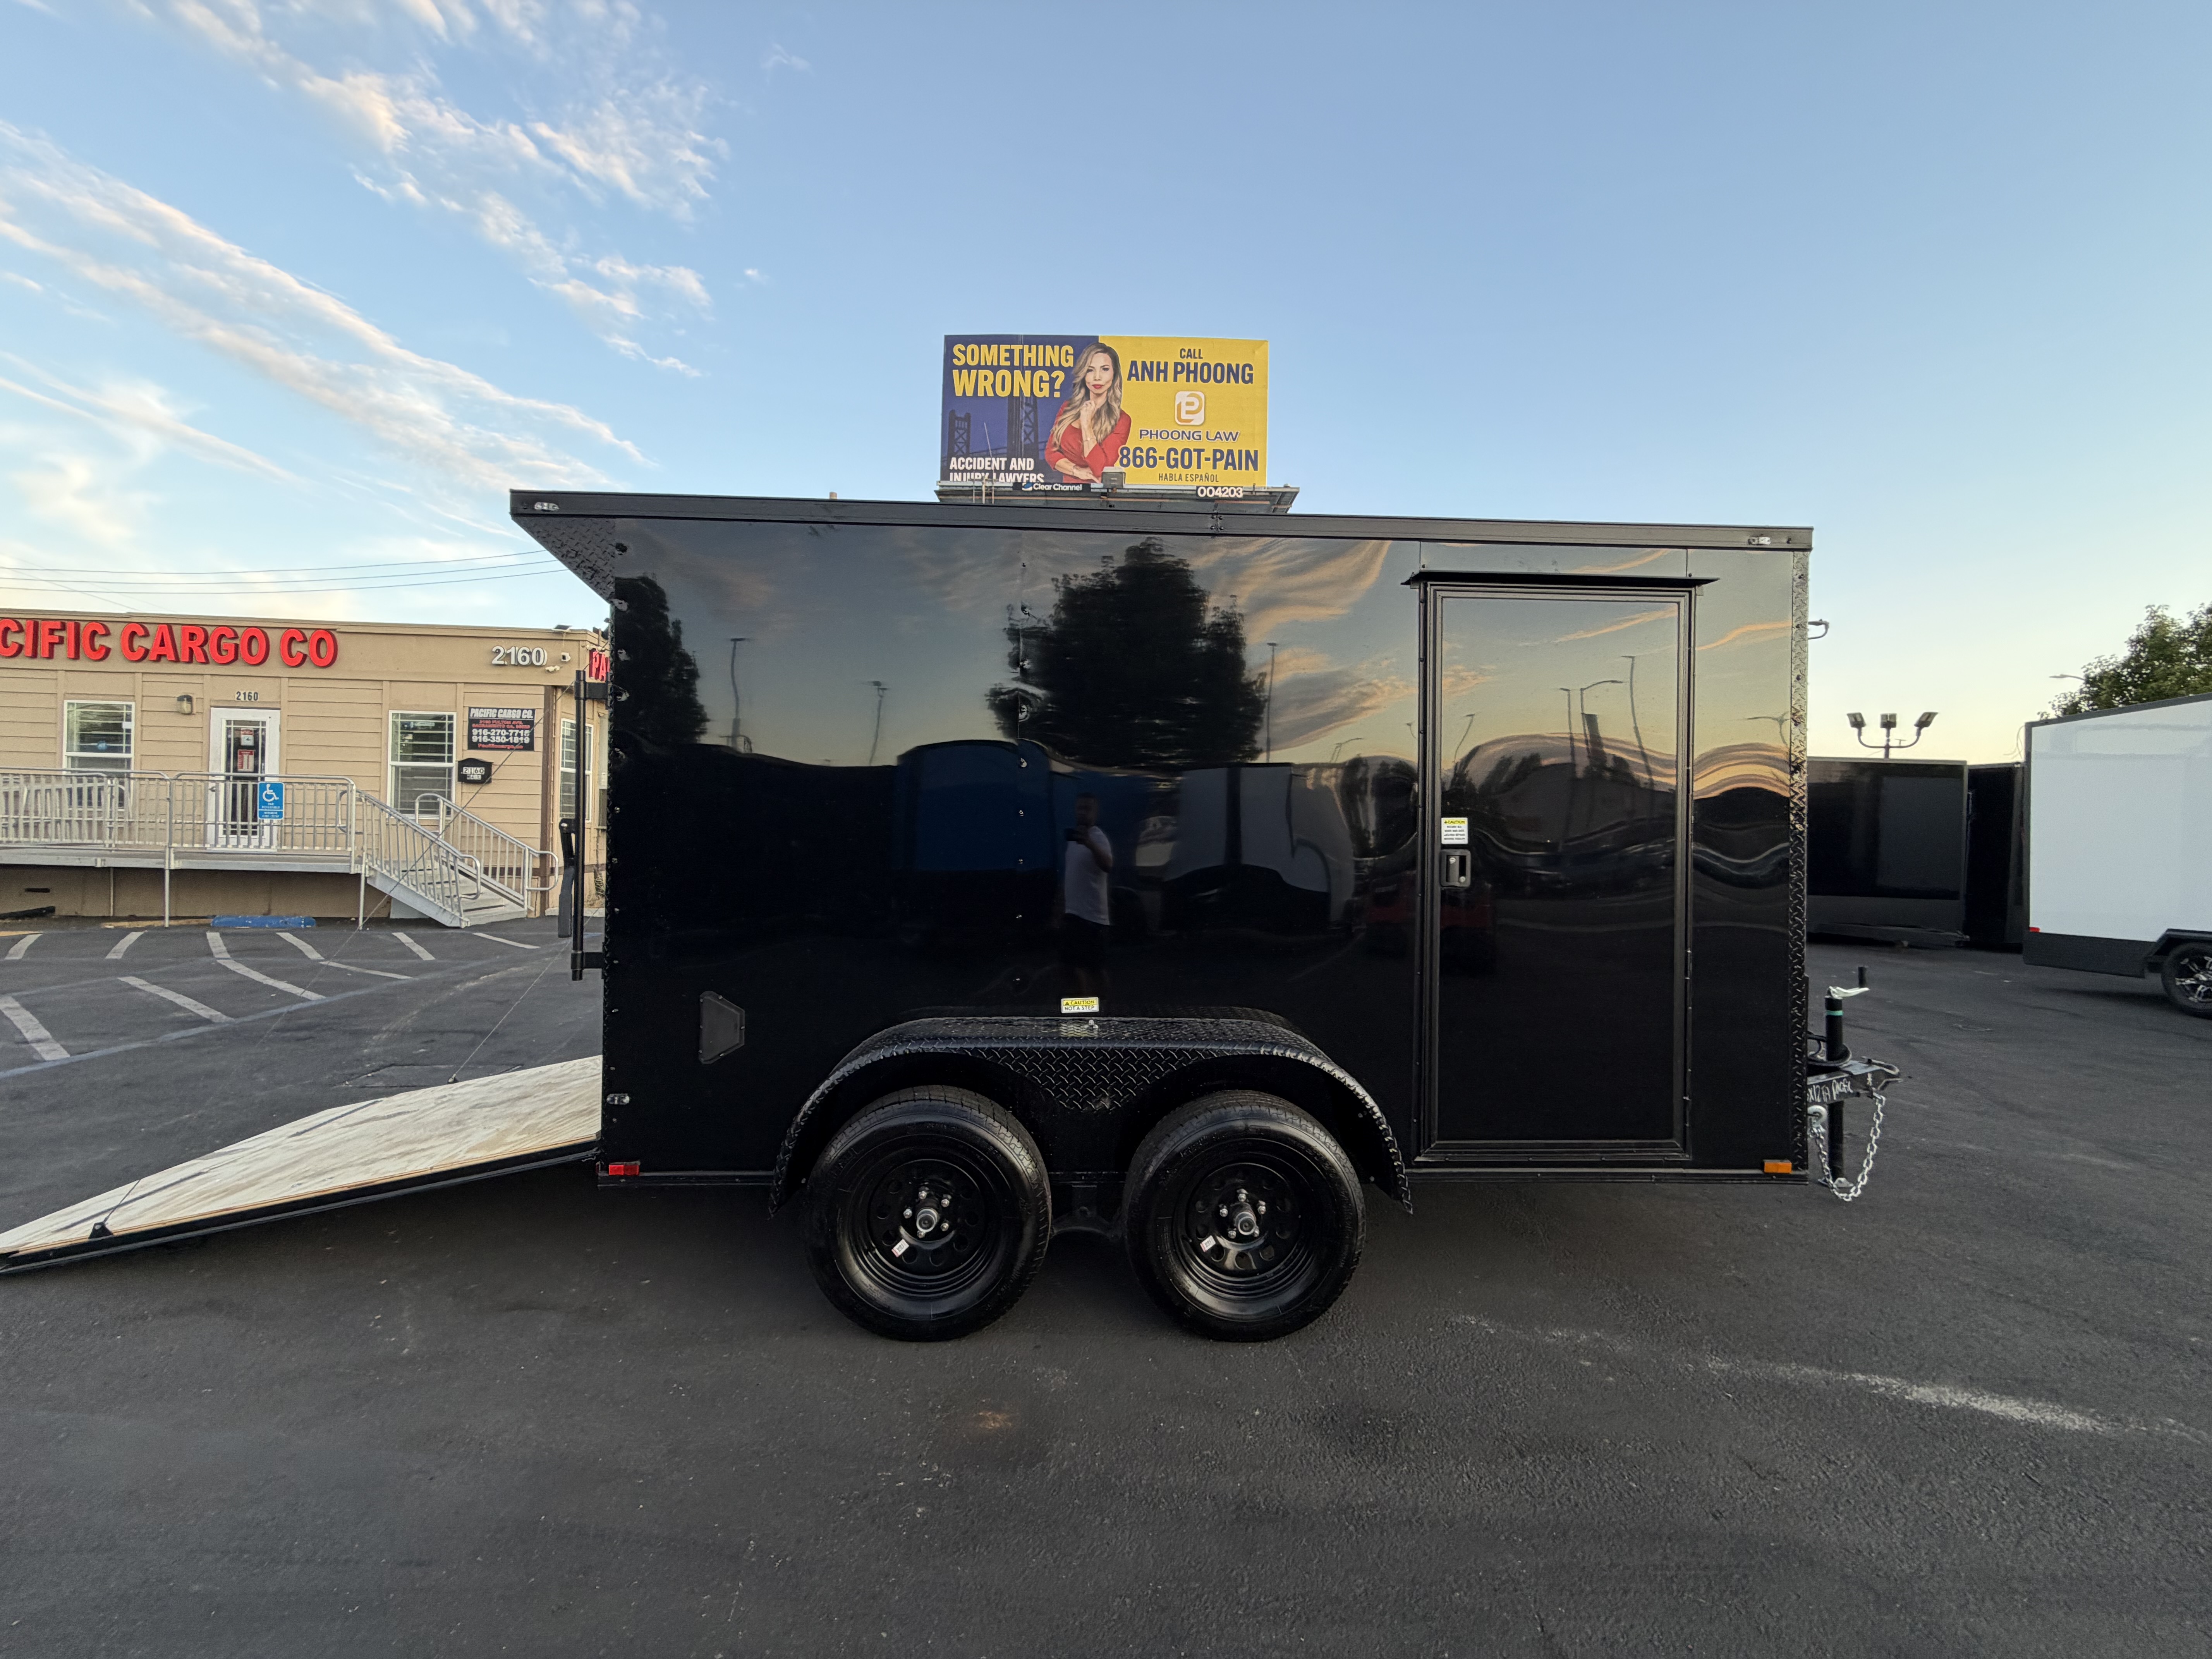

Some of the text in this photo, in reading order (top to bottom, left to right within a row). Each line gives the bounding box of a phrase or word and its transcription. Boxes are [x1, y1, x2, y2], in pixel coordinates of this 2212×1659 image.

[952, 344, 1074, 367] SOMETHING
[1180, 348, 1203, 359] CALL
[1127, 360, 1254, 384] ANH PHOONG
[952, 369, 1065, 398] WRONG?
[1139, 429, 1239, 442] PHOONG LAW
[950, 457, 1034, 471] ACCIDENT AND
[1119, 446, 1259, 471] 866-GOT-PAIN
[1158, 472, 1219, 483] HABLA ESPAÑOL
[1053, 483, 1082, 491] Channel
[1197, 486, 1243, 498] 004203
[0, 618, 336, 668] CIFIC CARGO CO
[492, 646, 546, 666] 2160
[236, 691, 258, 701] 2160
[470, 708, 497, 718] PACIFIC
[498, 709, 522, 718] CARGO
